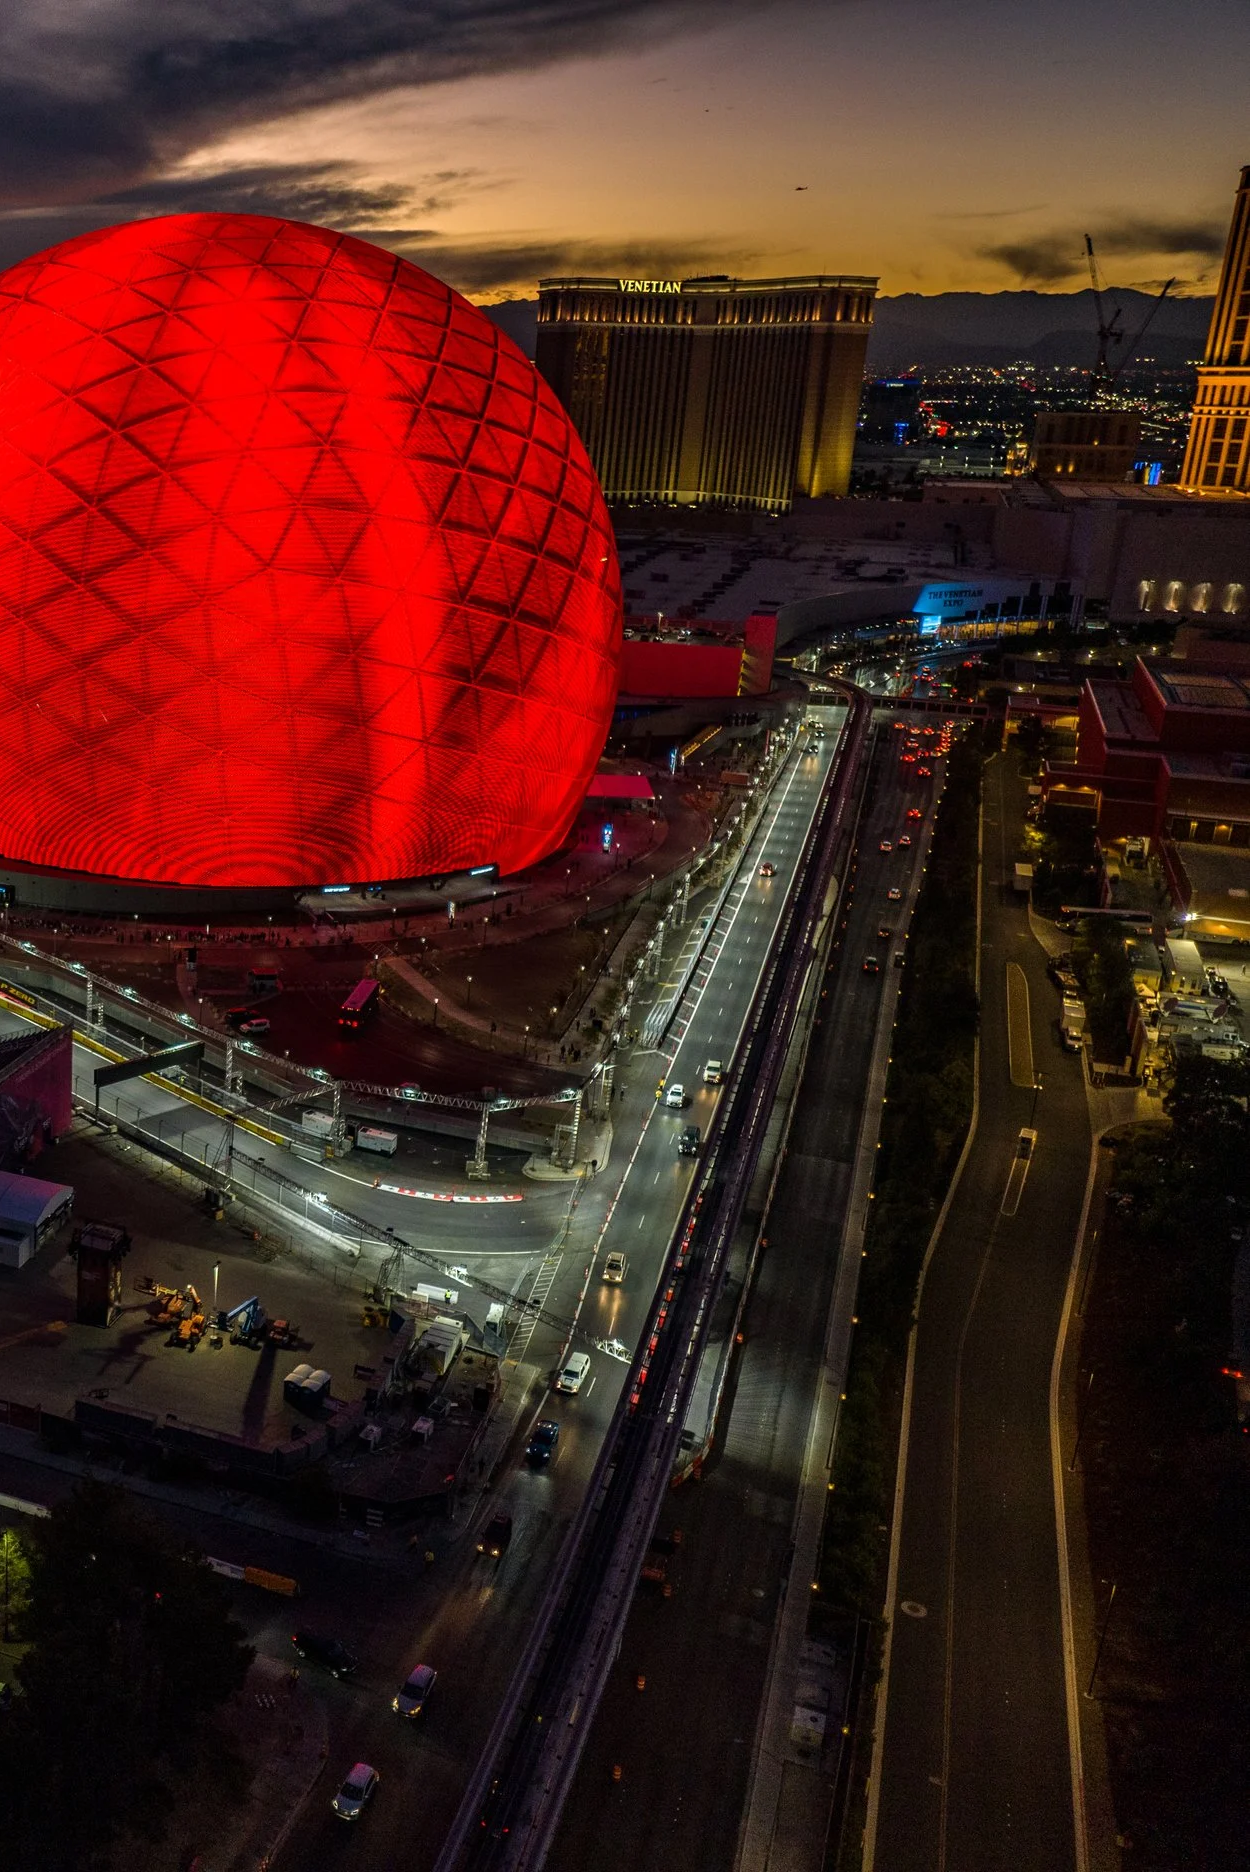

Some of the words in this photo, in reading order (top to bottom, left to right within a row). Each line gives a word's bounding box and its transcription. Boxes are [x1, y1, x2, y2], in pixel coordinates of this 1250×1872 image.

[619, 280, 682, 294] VENETIAN
[942, 589, 983, 599] VENETIAN
[9, 986, 36, 1005] ZERO
